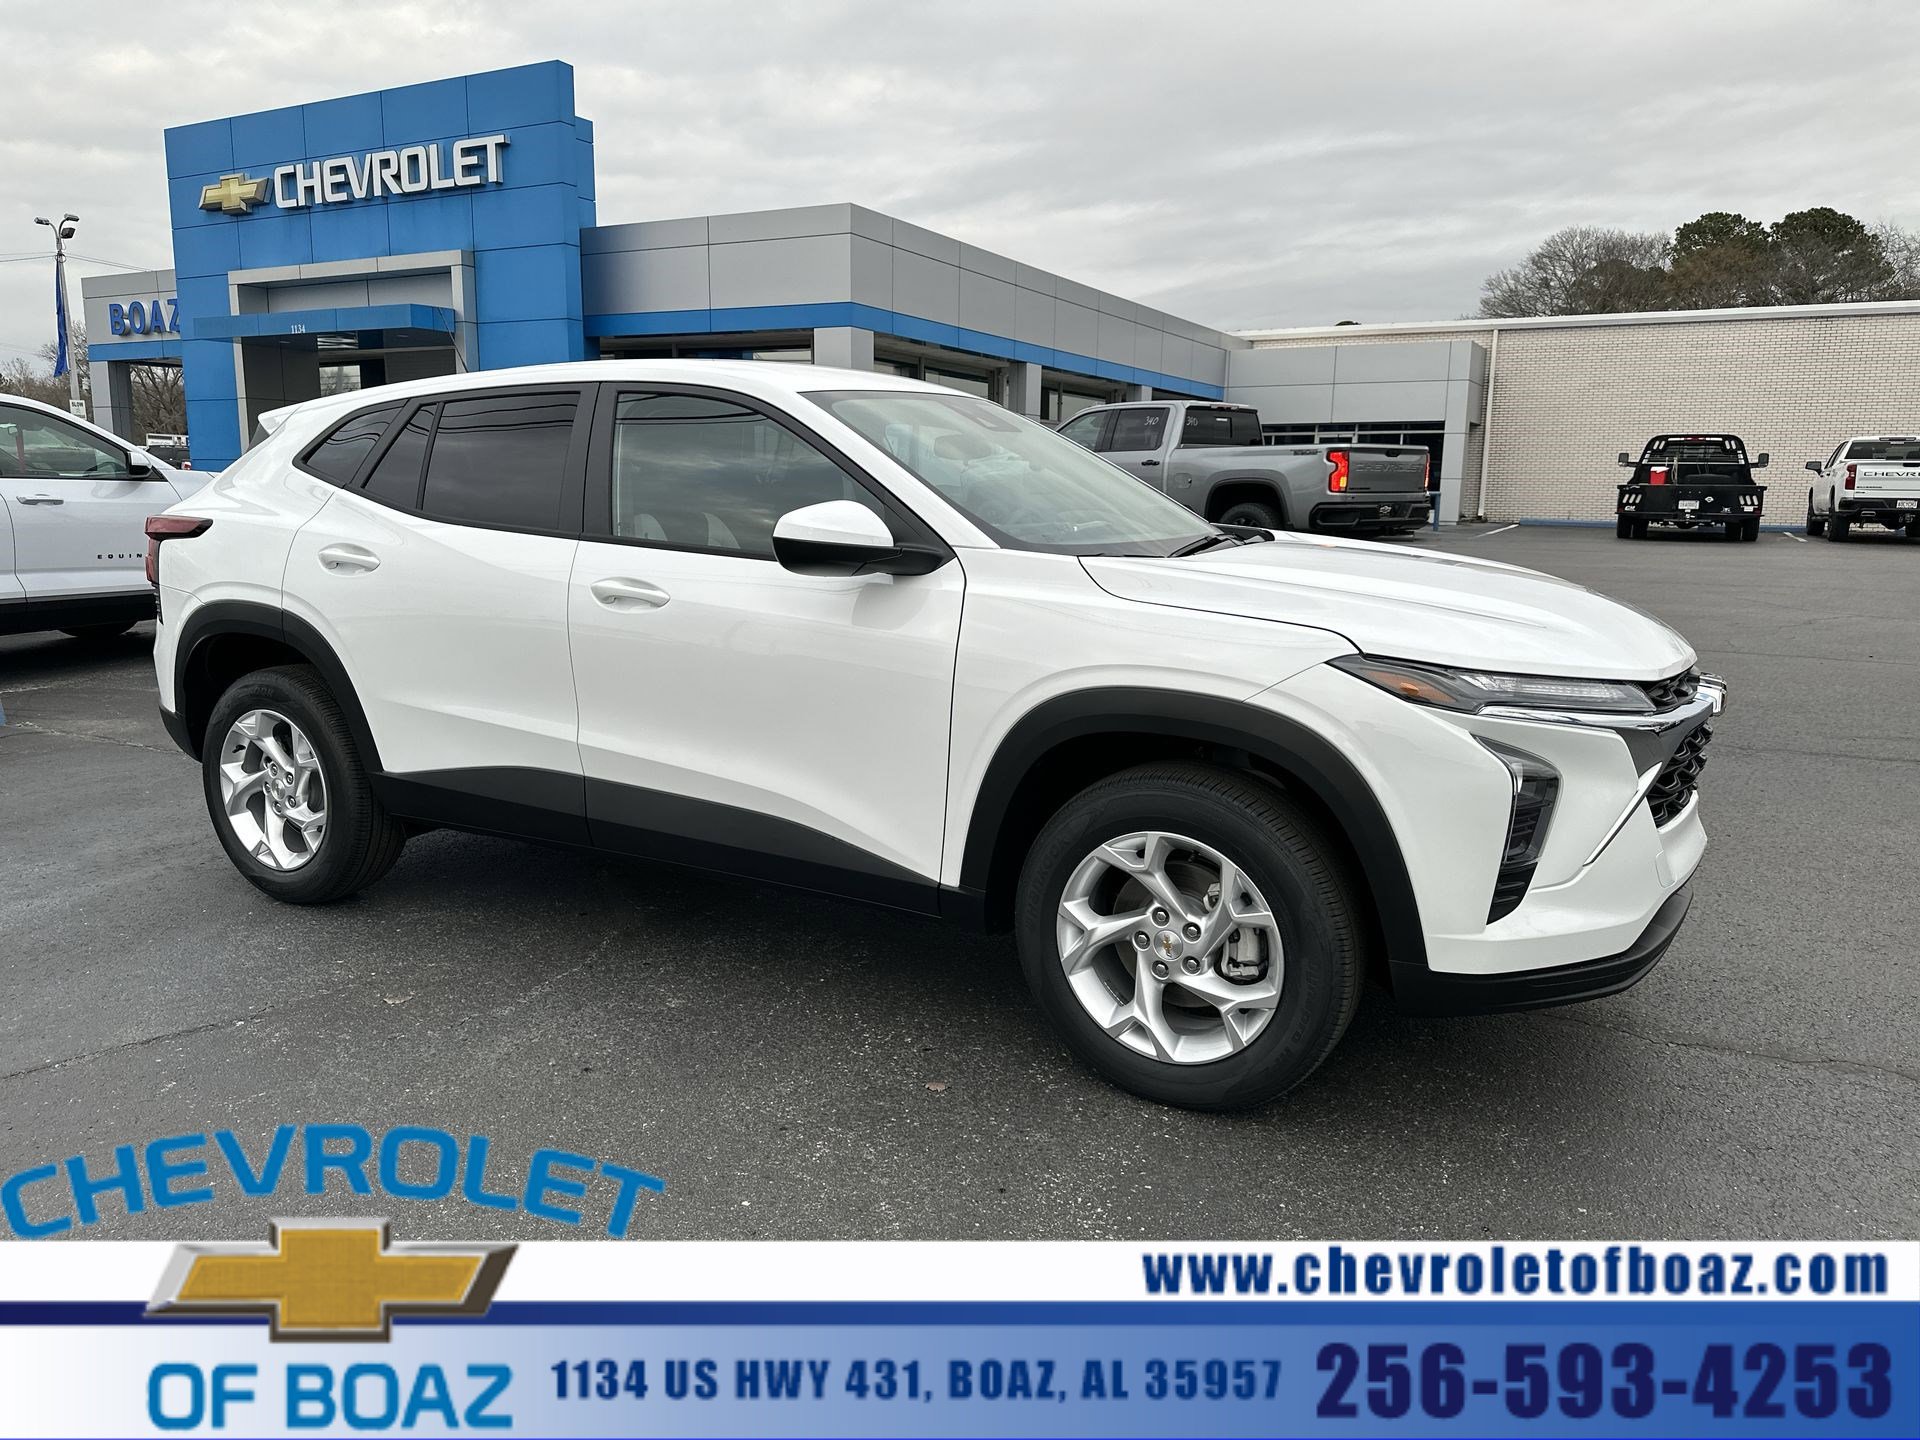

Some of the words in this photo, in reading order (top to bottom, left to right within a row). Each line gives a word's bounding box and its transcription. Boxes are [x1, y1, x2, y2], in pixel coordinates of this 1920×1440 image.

[274, 135, 509, 208] CHEVROLET
[109, 298, 180, 336] BOAZ
[291, 323, 306, 335] 1134
